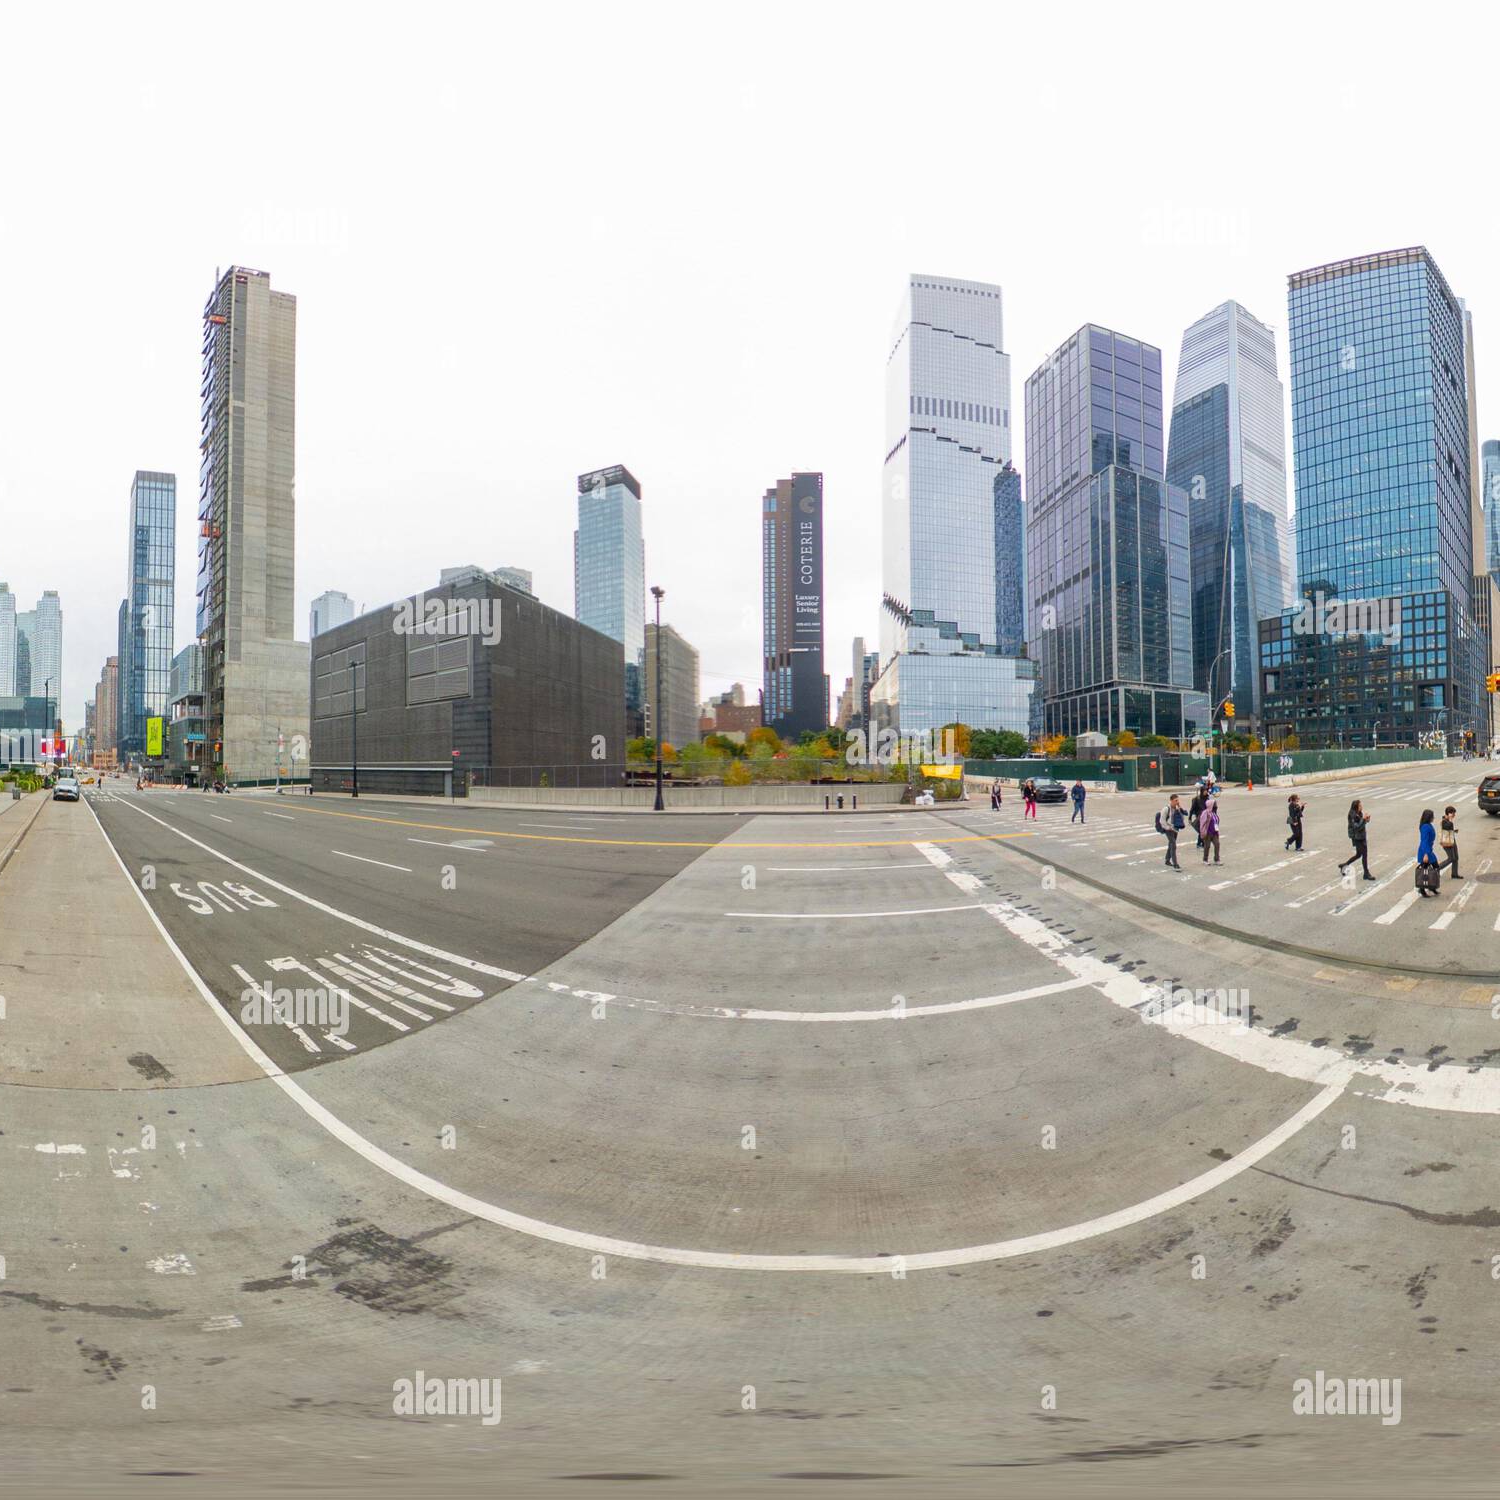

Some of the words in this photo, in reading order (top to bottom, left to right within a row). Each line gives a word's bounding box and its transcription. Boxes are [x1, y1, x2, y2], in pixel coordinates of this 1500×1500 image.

[801, 521, 813, 585] COTERIE
[795, 594, 820, 602] Luxury
[170, 881, 281, 914] BUS
